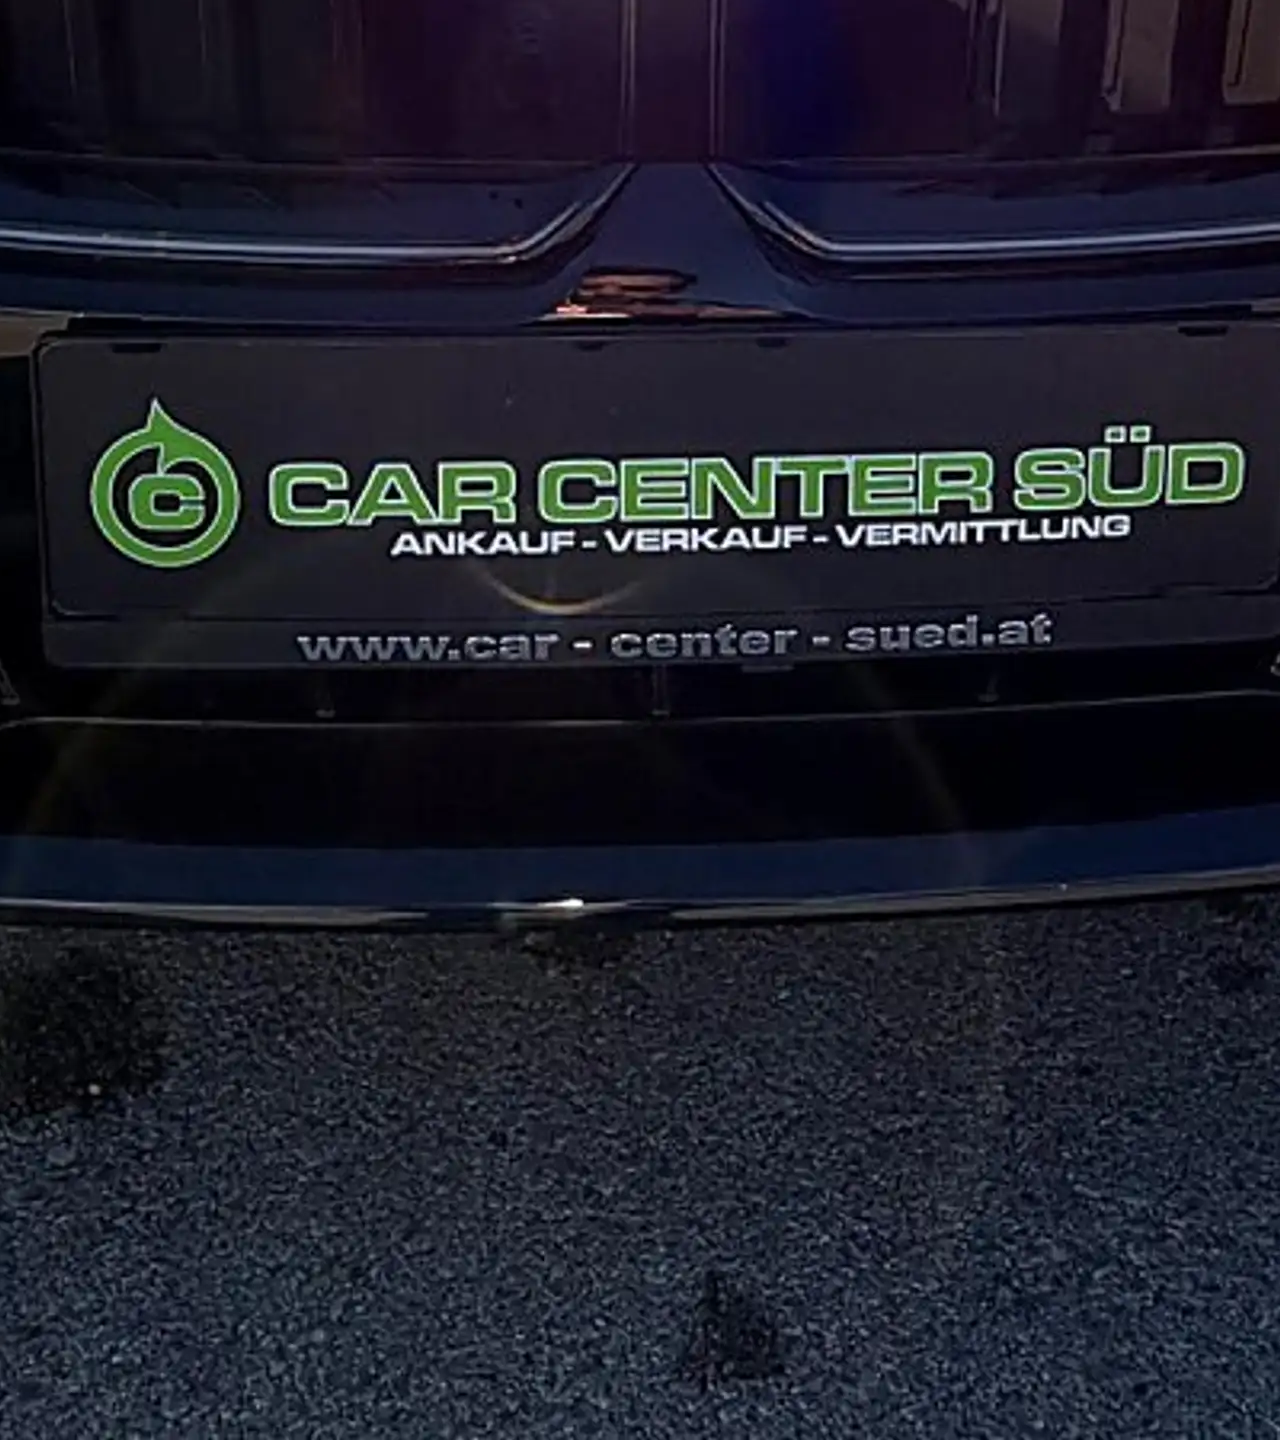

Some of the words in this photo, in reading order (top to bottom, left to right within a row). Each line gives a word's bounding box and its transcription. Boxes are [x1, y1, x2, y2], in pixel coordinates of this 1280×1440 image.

[268, 459, 517, 527] CAR
[537, 451, 994, 524] CENTER
[1013, 425, 1245, 511] SÜD
[390, 529, 577, 556] ANKAUF
[603, 525, 808, 553] VERKAUF
[834, 514, 1131, 548] VERMITTLUNG
[611, 623, 799, 658] center
